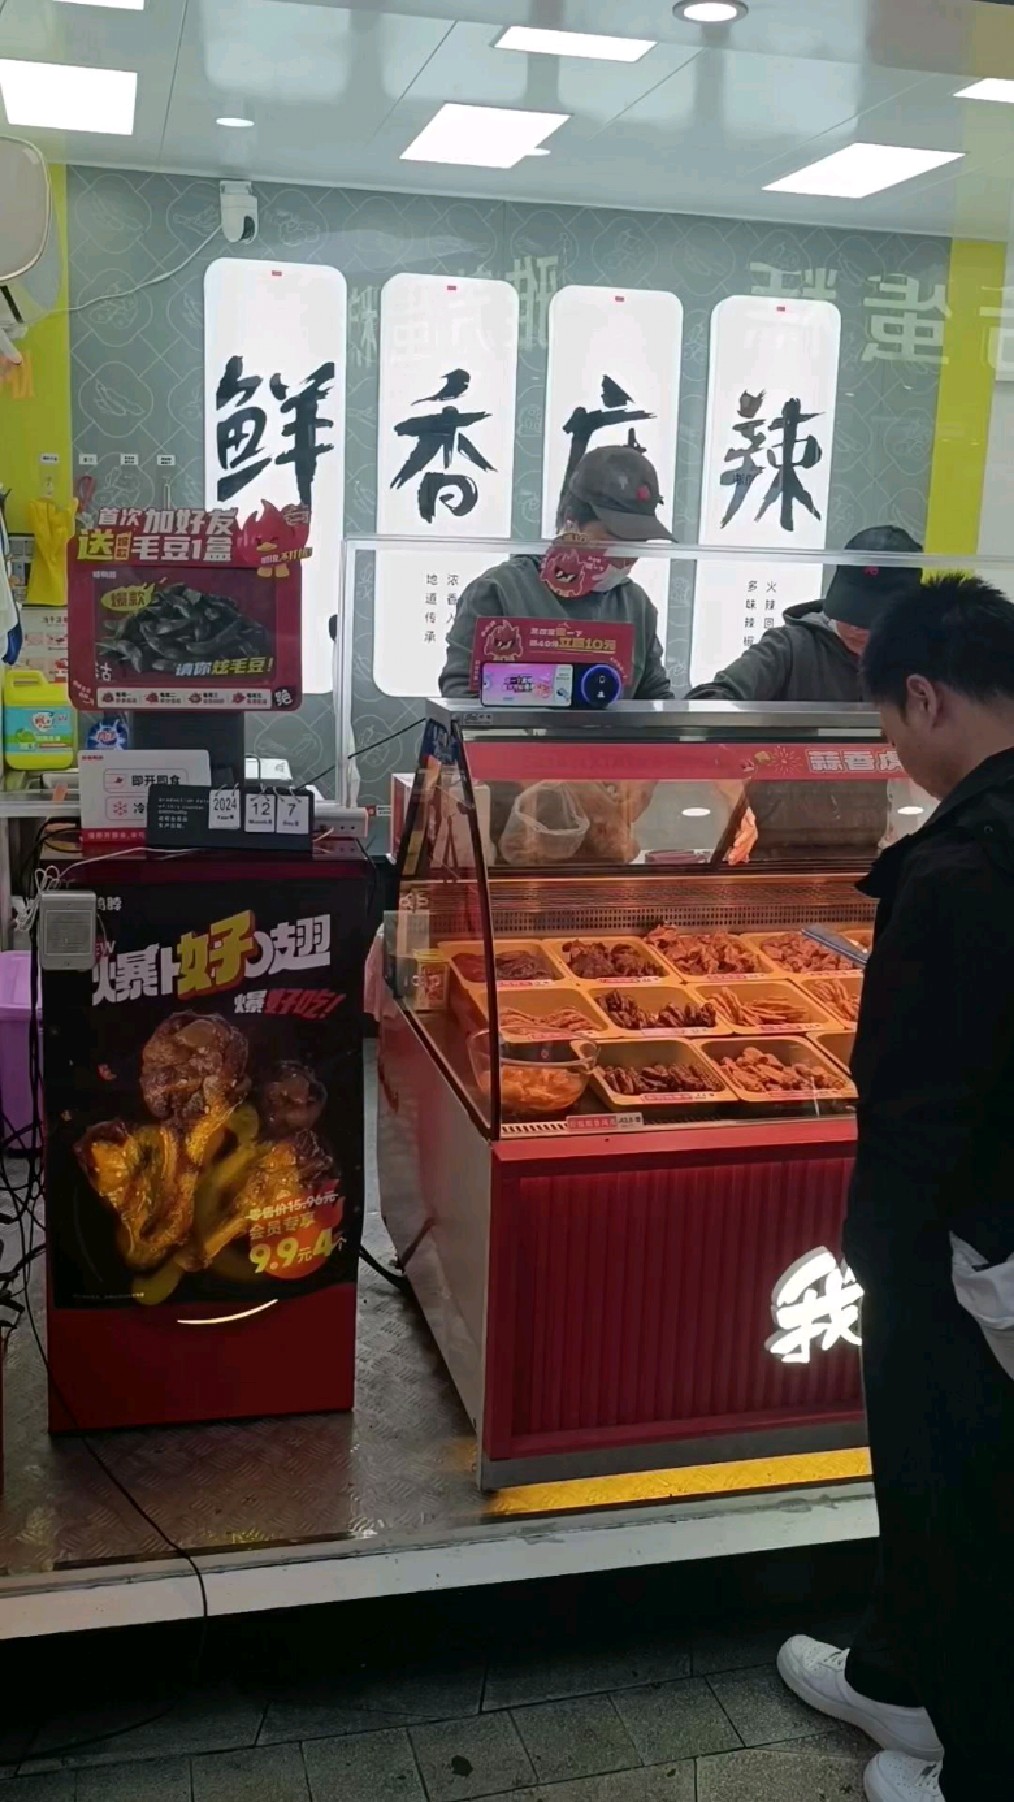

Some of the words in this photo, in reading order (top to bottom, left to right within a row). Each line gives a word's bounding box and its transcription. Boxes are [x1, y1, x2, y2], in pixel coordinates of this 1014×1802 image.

[216, 355, 335, 508] 鲜
[390, 368, 498, 524] 香
[720, 388, 827, 532] 辣
[98, 508, 238, 535] 首次加好友
[212, 797, 238, 811] 2024
[251, 802, 270, 816] 12
[286, 802, 296, 816] 7
[766, 1247, 864, 1363] 我
